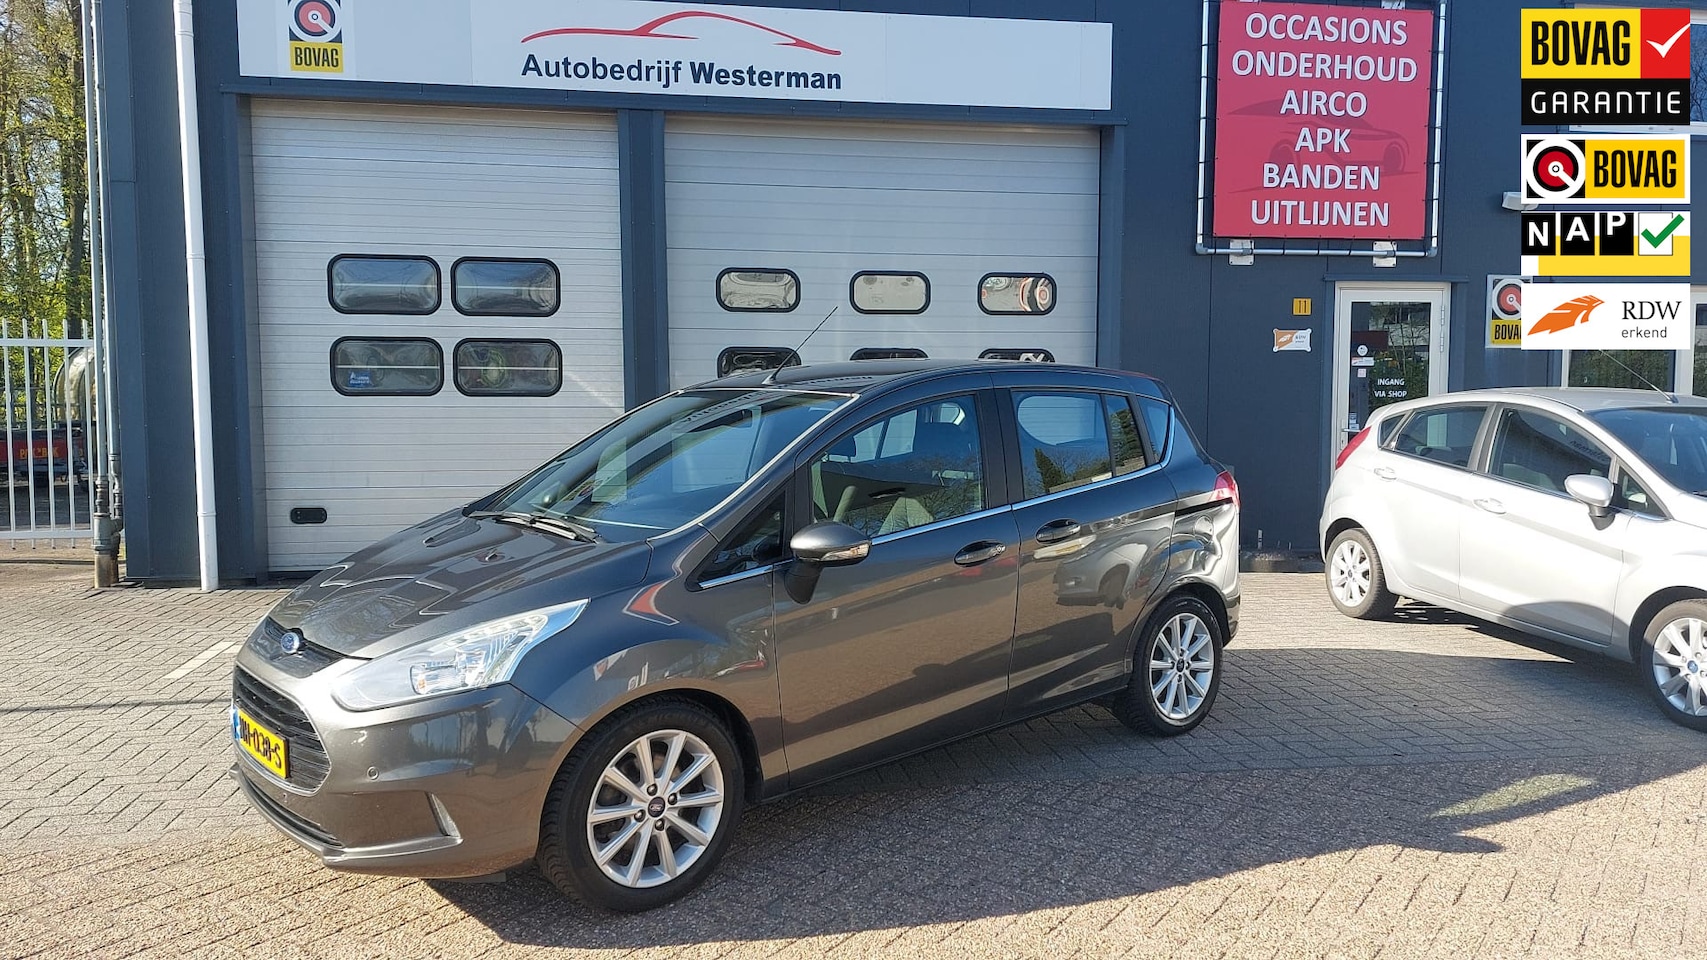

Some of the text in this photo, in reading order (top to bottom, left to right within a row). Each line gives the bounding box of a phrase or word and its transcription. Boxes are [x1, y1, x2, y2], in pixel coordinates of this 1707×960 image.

[1245, 12, 1408, 46] OCCASIONS
[294, 46, 339, 68] BOVAG
[1232, 50, 1418, 82] ONDERHOUD
[521, 54, 842, 90] Autobedrijf Westerman
[1279, 90, 1368, 117] AIRCO
[1294, 127, 1351, 153] APK
[1263, 163, 1380, 190] BANDEN
[1251, 199, 1390, 227] UITLIJNEN
[1298, 300, 1307, 313] 11
[1494, 324, 1521, 340] BOVA
[1374, 390, 1408, 398] VIA SHOP
[1377, 378, 1405, 386] INGANG
